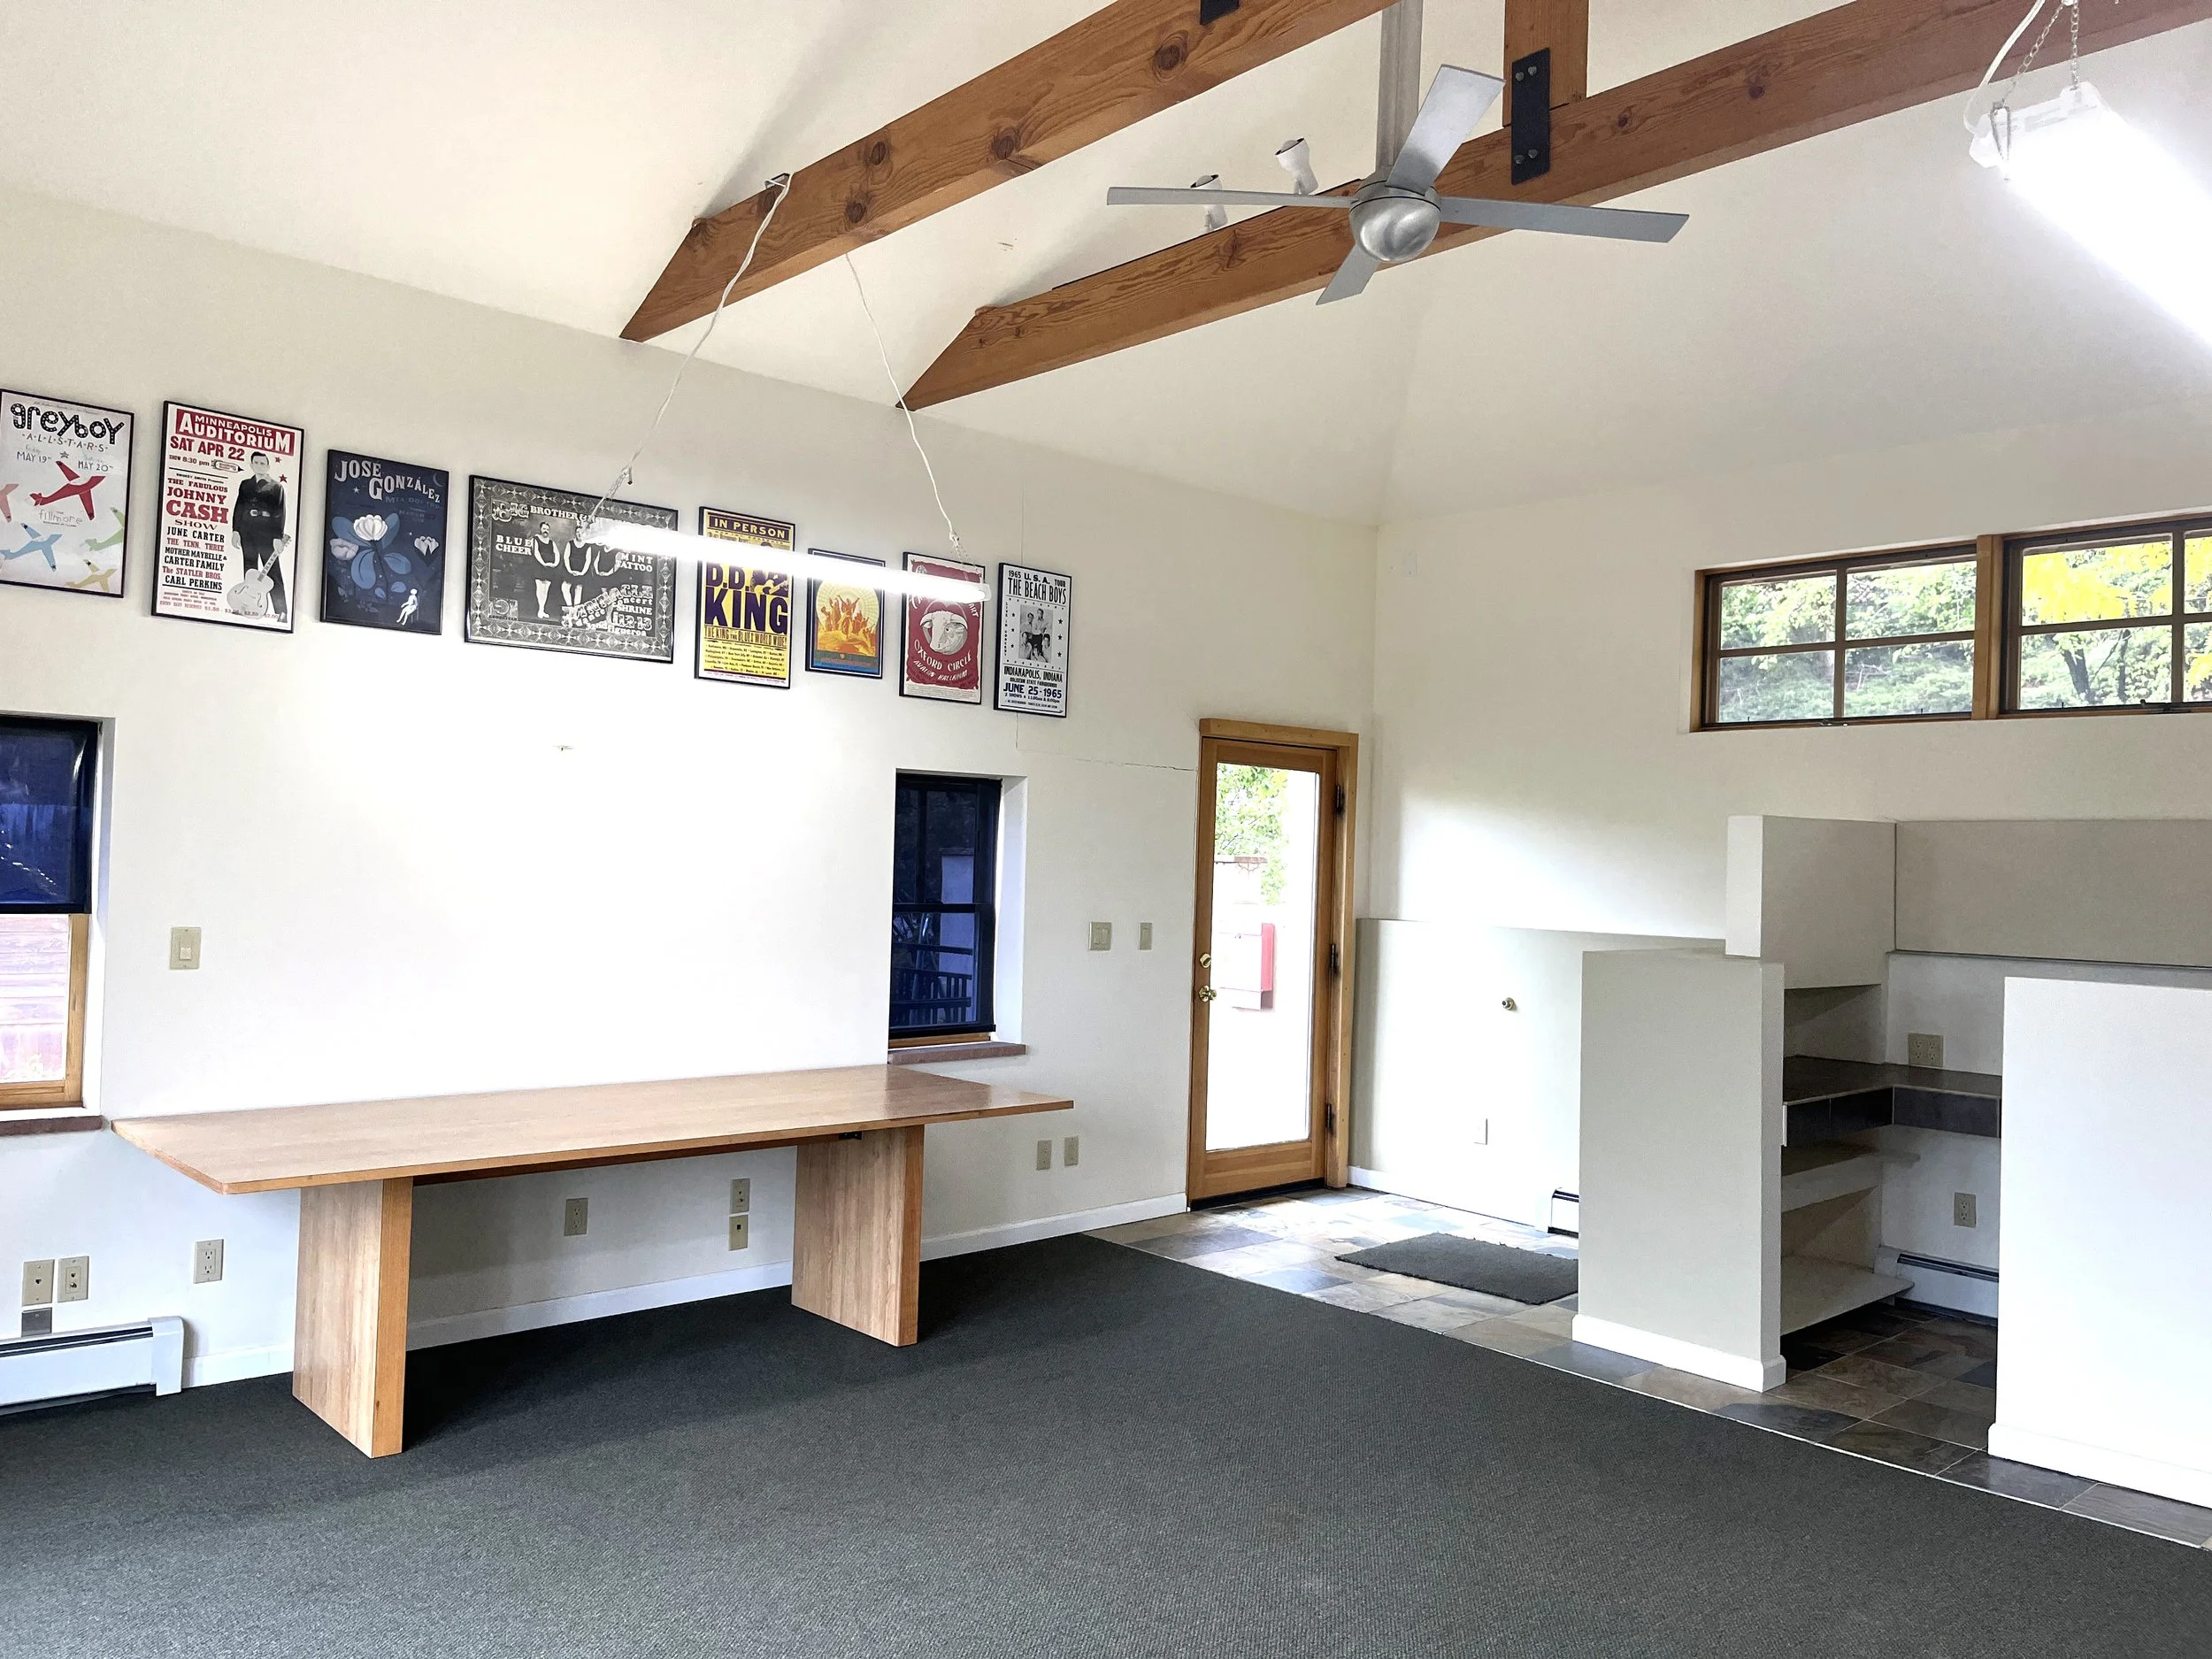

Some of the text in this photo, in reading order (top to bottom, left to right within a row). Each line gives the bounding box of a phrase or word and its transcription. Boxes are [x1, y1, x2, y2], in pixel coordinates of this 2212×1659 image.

[179, 412, 291, 454] AUDITORIUM
[195, 415, 273, 437] MINNEAPOLIS
[17, 451, 35, 463] MAY
[170, 435, 245, 462] SAT APR 22
[78, 460, 94, 471] MAY
[182, 456, 197, 465] 8:30
[188, 480, 228, 493] FABULOUS
[368, 474, 441, 503] GONZÁLEZ
[166, 486, 227, 505] JOHNNY
[165, 499, 229, 524] CASH
[530, 505, 579, 520] BROTHER
[174, 518, 218, 531] SHOW
[714, 518, 727, 529] IN
[733, 521, 785, 539] PERSON
[166, 526, 225, 543] JUNE CARTER
[495, 534, 534, 548] BLUE
[166, 537, 179, 546] THE
[204, 542, 225, 552] THREE
[495, 542, 533, 556] CHEER
[165, 546, 190, 557] MOTHER
[190, 549, 223, 562] MAYBELLE
[620, 552, 653, 565] MINT
[162, 565, 173, 574] The
[175, 567, 203, 578] STATLER
[164, 555, 225, 572] CARTER FAMILY
[617, 560, 653, 572] TATTOO
[165, 574, 223, 591] CARL PERKINS
[1008, 570, 1022, 579] 1965
[1054, 579, 1066, 588] TOUR
[1008, 577, 1067, 605] THE BEACH BOYS
[616, 604, 653, 615] SHRINE
[704, 586, 788, 635] KING
[704, 626, 715, 638] THE
[716, 627, 729, 640] KING
[738, 629, 754, 642] BLUES
[755, 633, 772, 646] WORLD
[914, 639, 972, 672] OXFORD CIRCLE
[1003, 665, 1063, 683] INDIANAPOLIS, INDIANA
[1002, 682, 1025, 694] JUNE
[1027, 685, 1039, 696] 25
[1042, 687, 1063, 699] 1965
